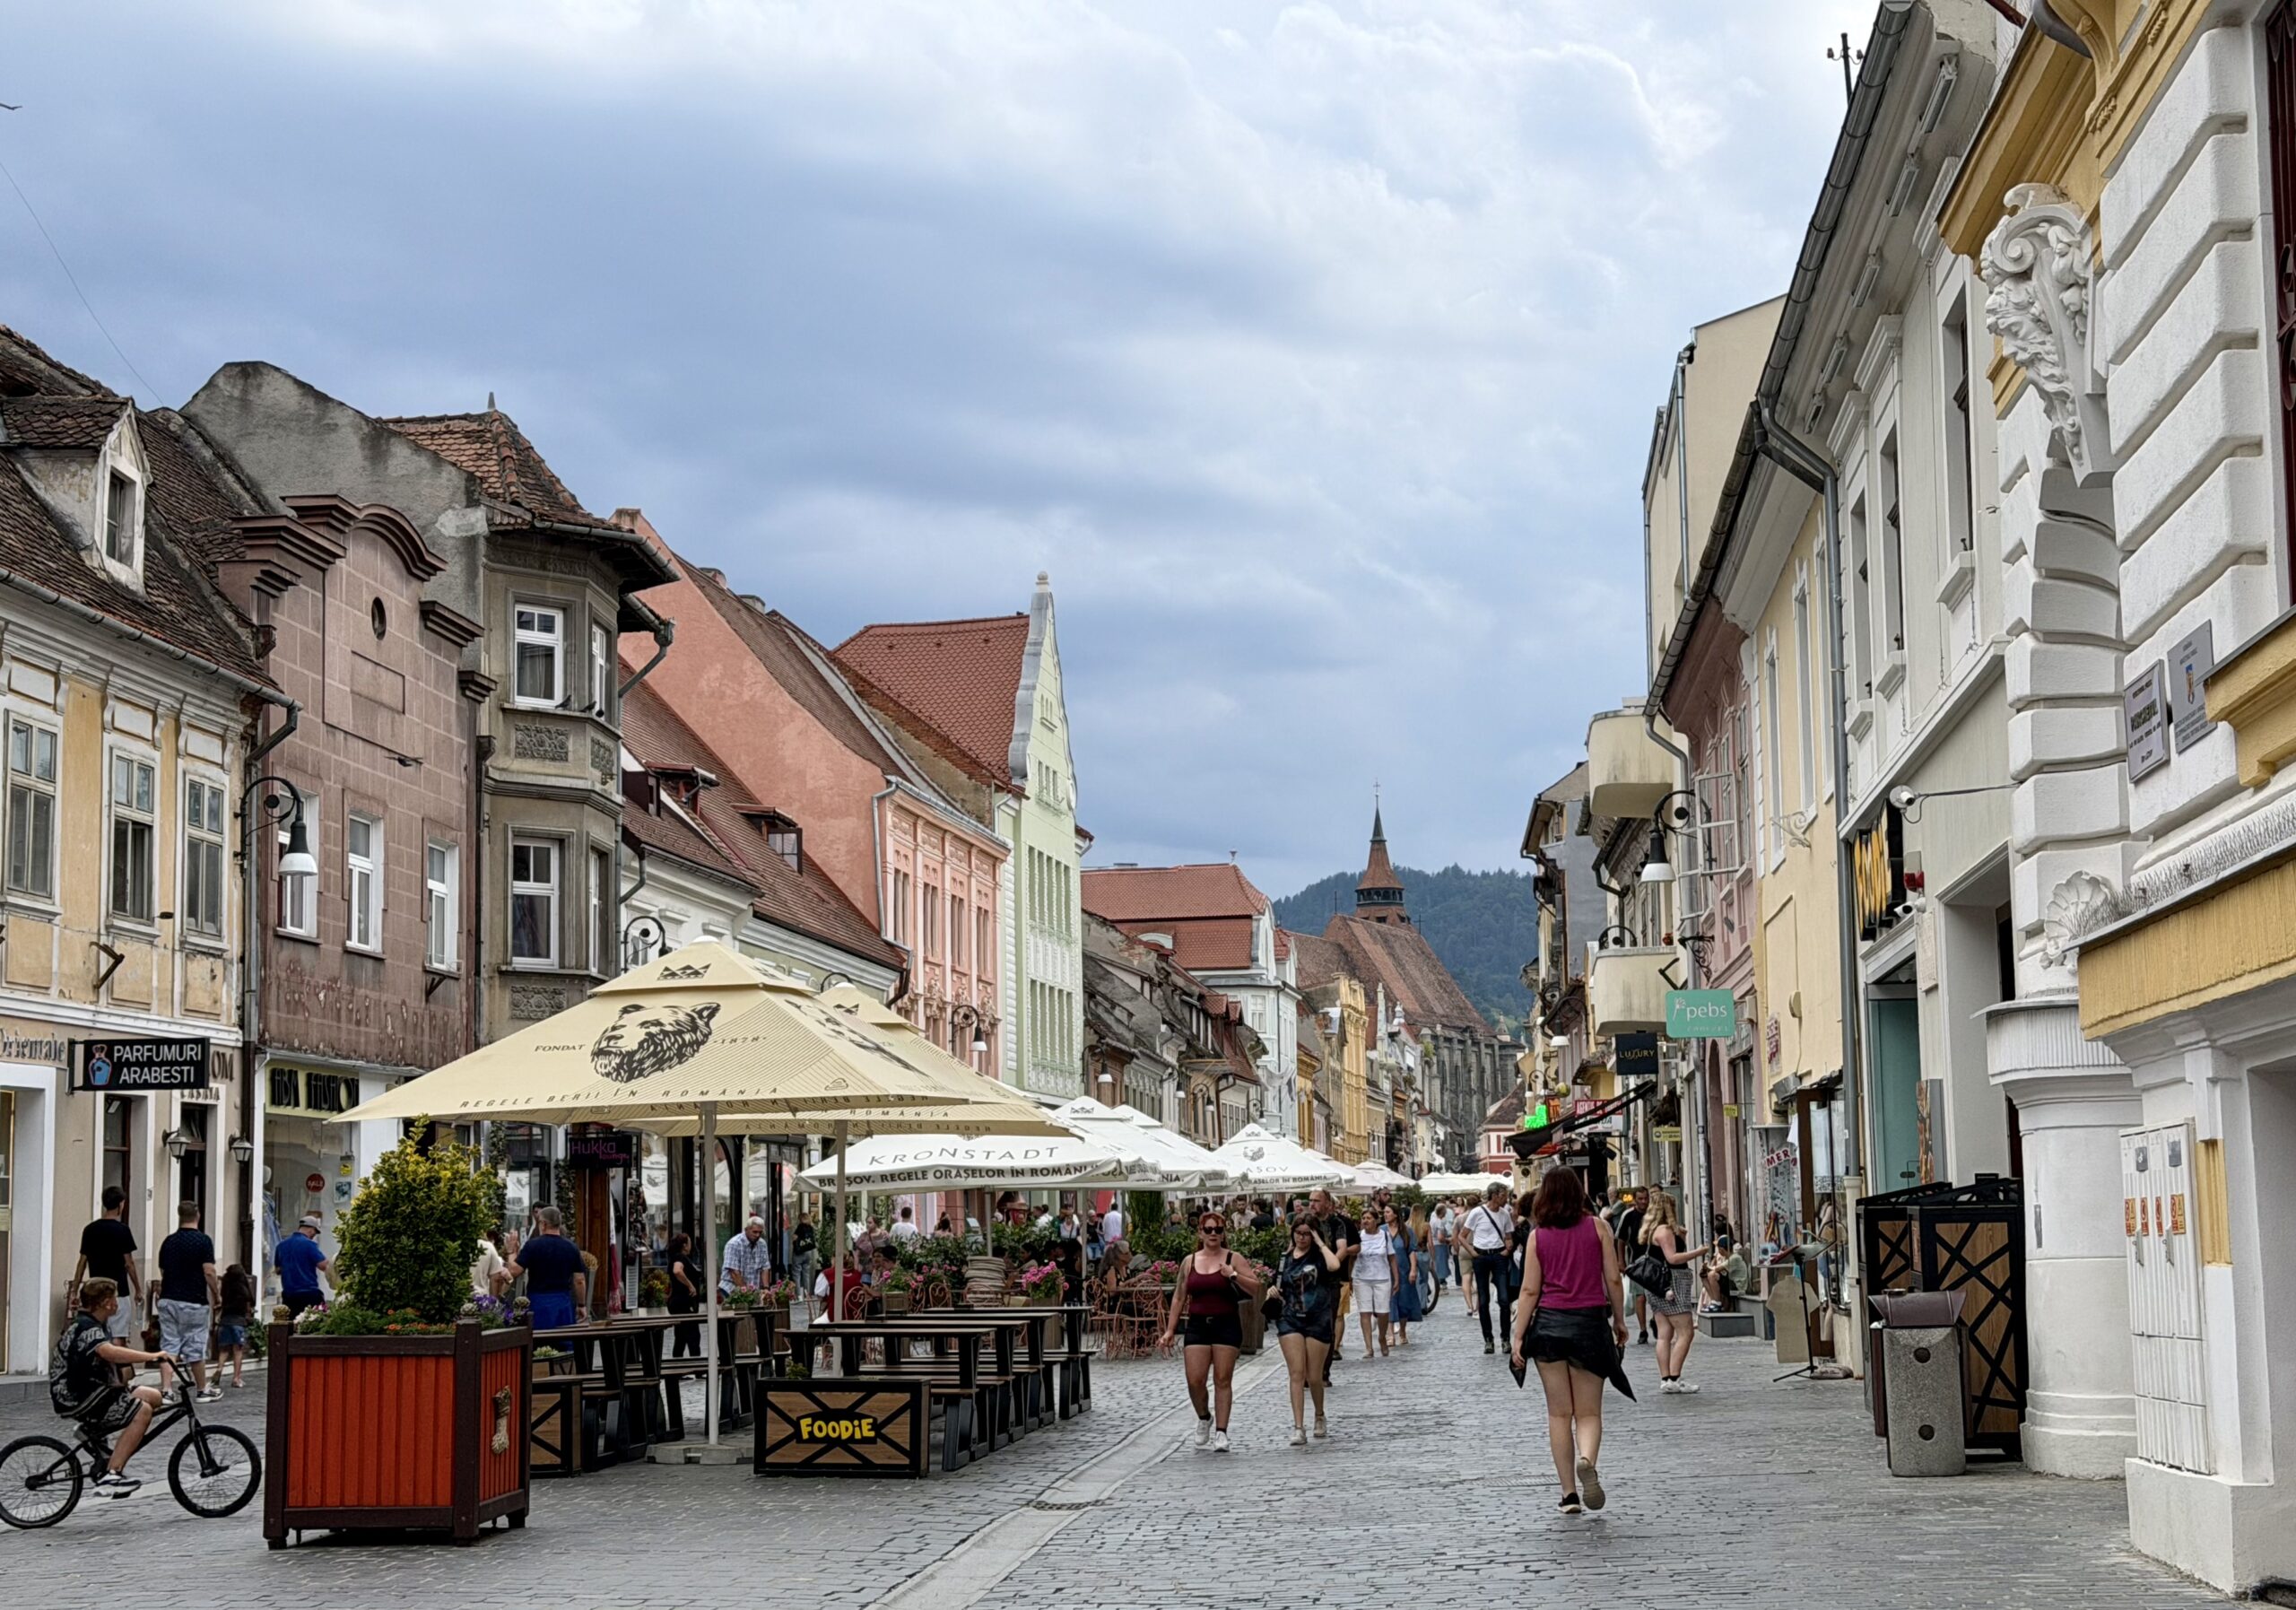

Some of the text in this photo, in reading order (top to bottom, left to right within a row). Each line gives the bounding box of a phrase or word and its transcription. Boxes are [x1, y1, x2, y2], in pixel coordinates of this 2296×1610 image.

[1686, 1002, 1727, 1022] pebs
[113, 1044, 202, 1063] PARFUMURI
[534, 1044, 587, 1052] FONDAT
[118, 1066, 195, 1084] ARABESTI
[459, 1097, 535, 1109] REGELE
[545, 1092, 601, 1103] BERII
[661, 1087, 778, 1097] ROMÂNIA
[571, 1139, 616, 1155] Hukka
[868, 1146, 1059, 1166] KRONSTADT
[818, 1175, 875, 1188] BRȘOV.
[881, 1170, 928, 1182] REGELE
[1011, 1165, 1024, 1178] ÎN
[1031, 1163, 1099, 1177] ROMÂNI
